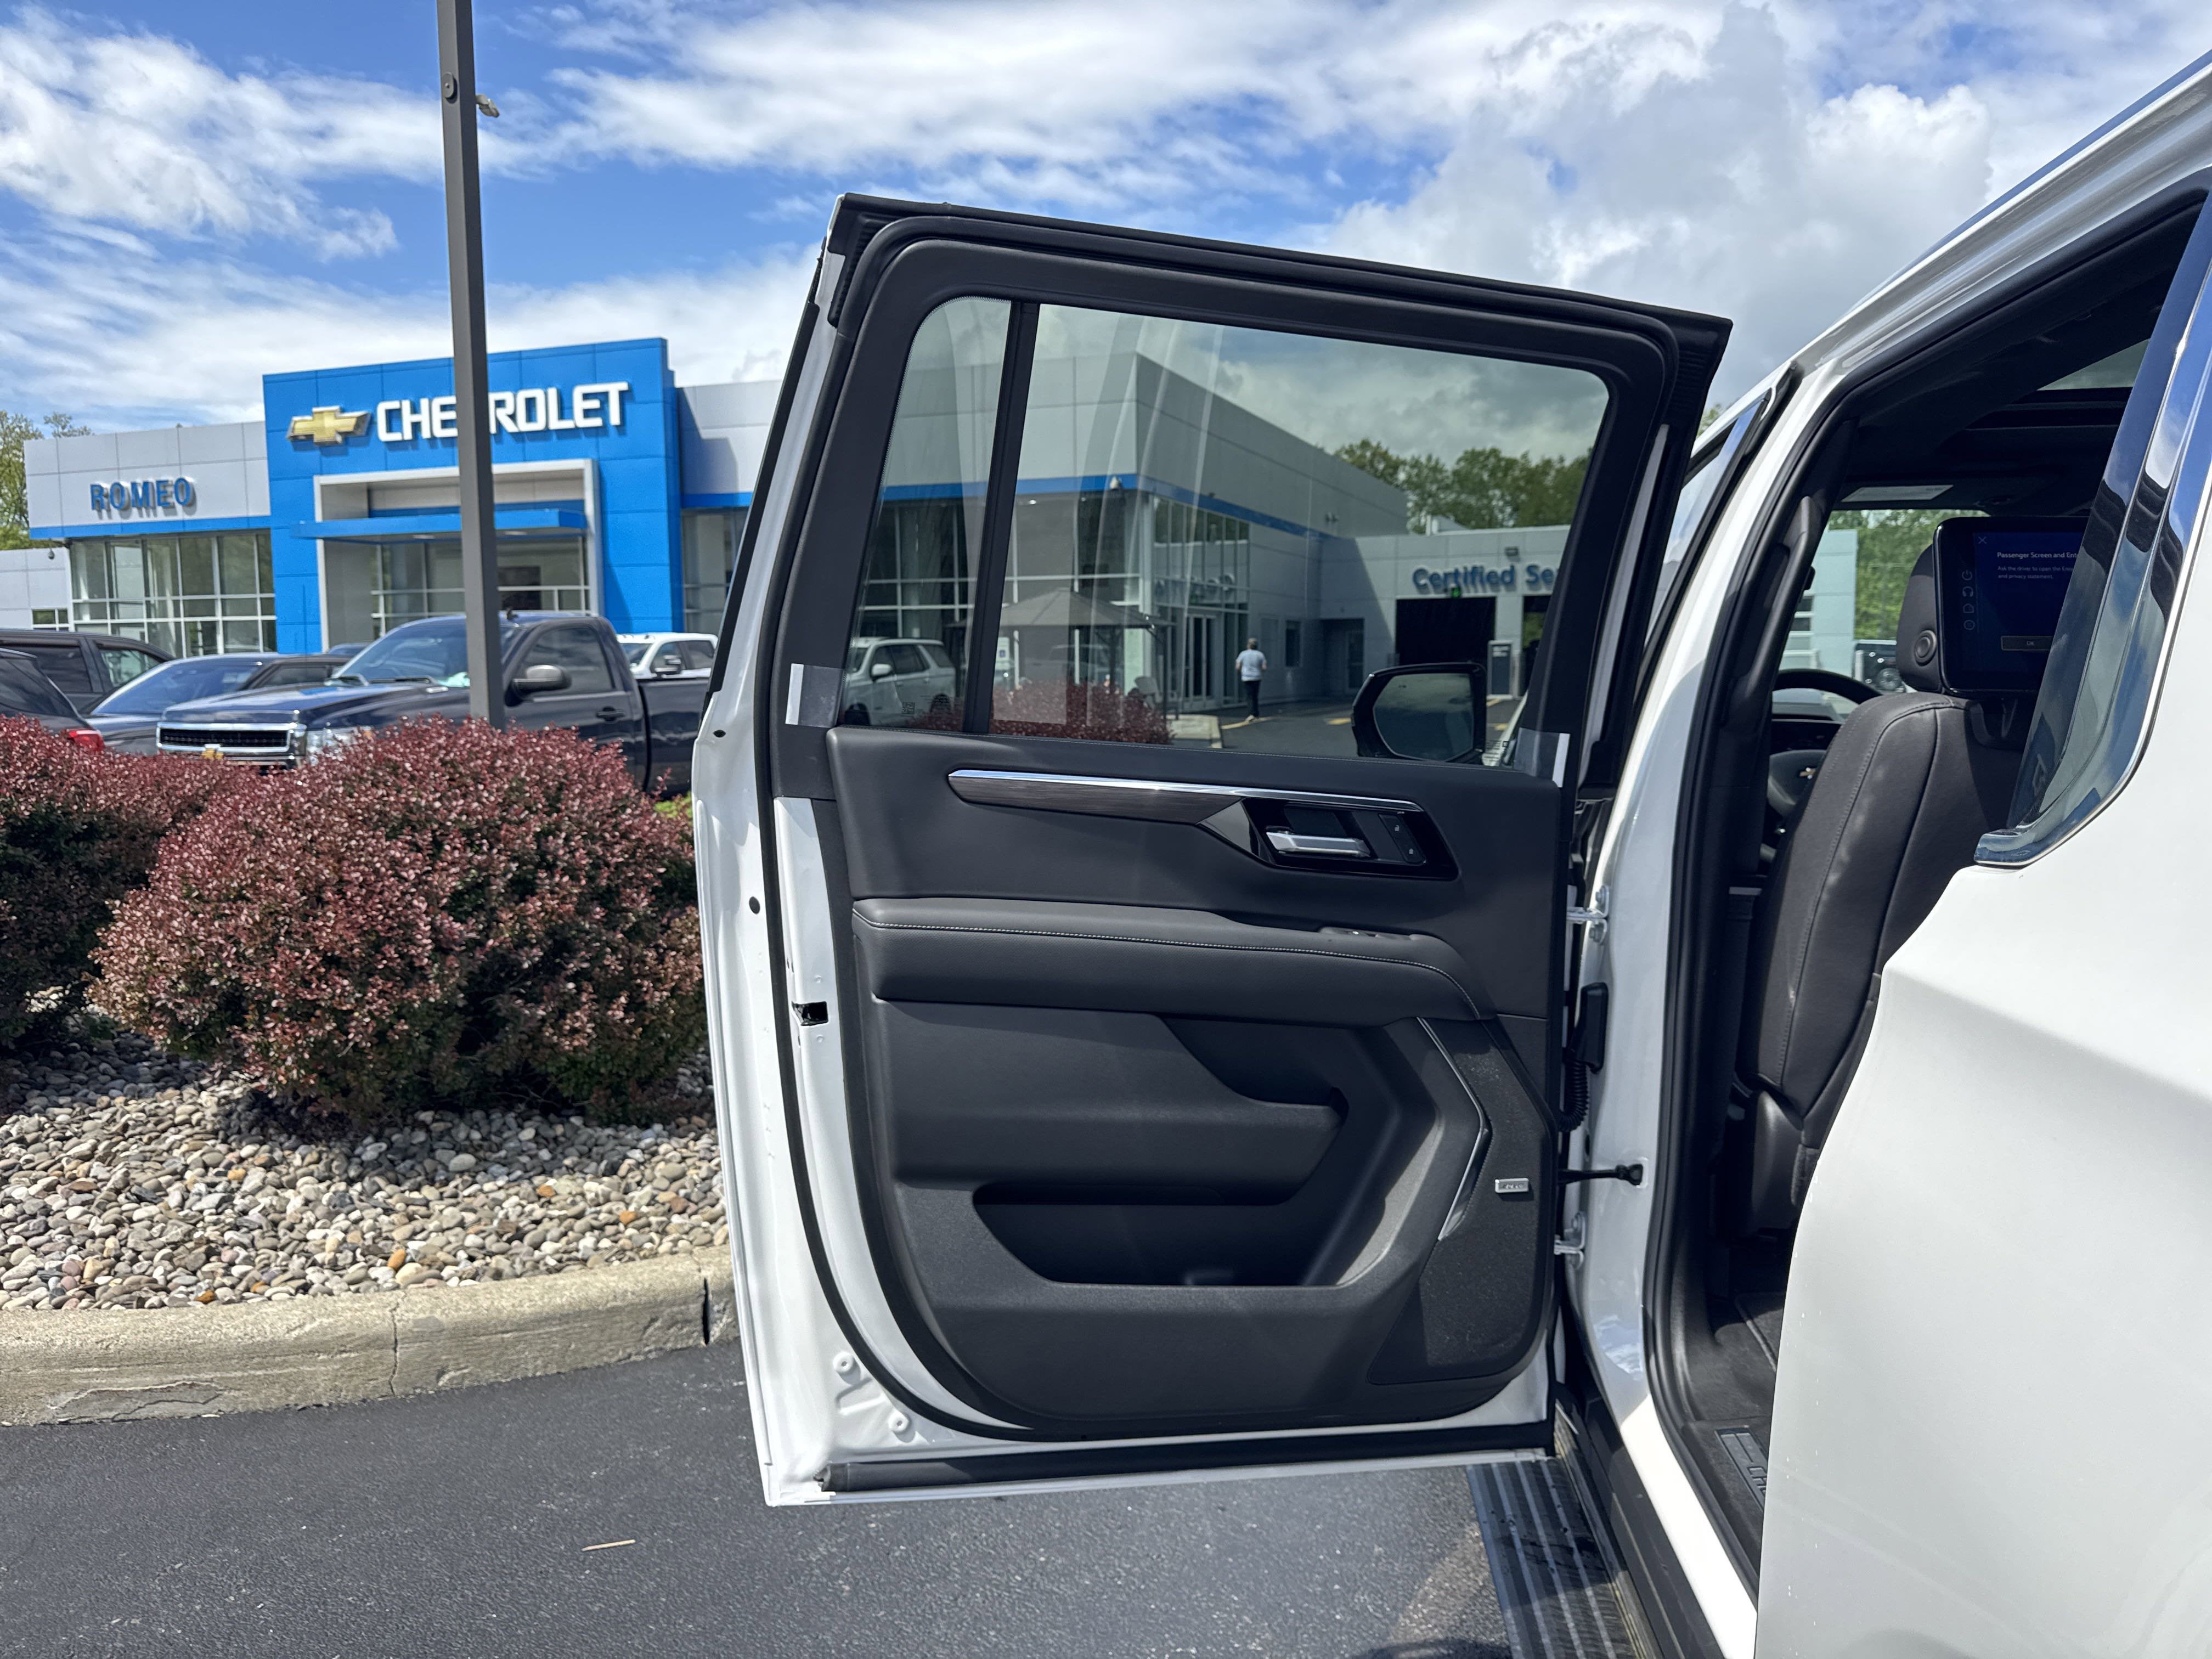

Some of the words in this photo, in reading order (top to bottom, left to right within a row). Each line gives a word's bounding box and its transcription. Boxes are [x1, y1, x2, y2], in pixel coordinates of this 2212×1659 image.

[377, 381, 629, 442] CHEROLET
[91, 477, 192, 510] ROMEO
[1413, 565, 1514, 588] Certified
[1526, 564, 1560, 585] Se
